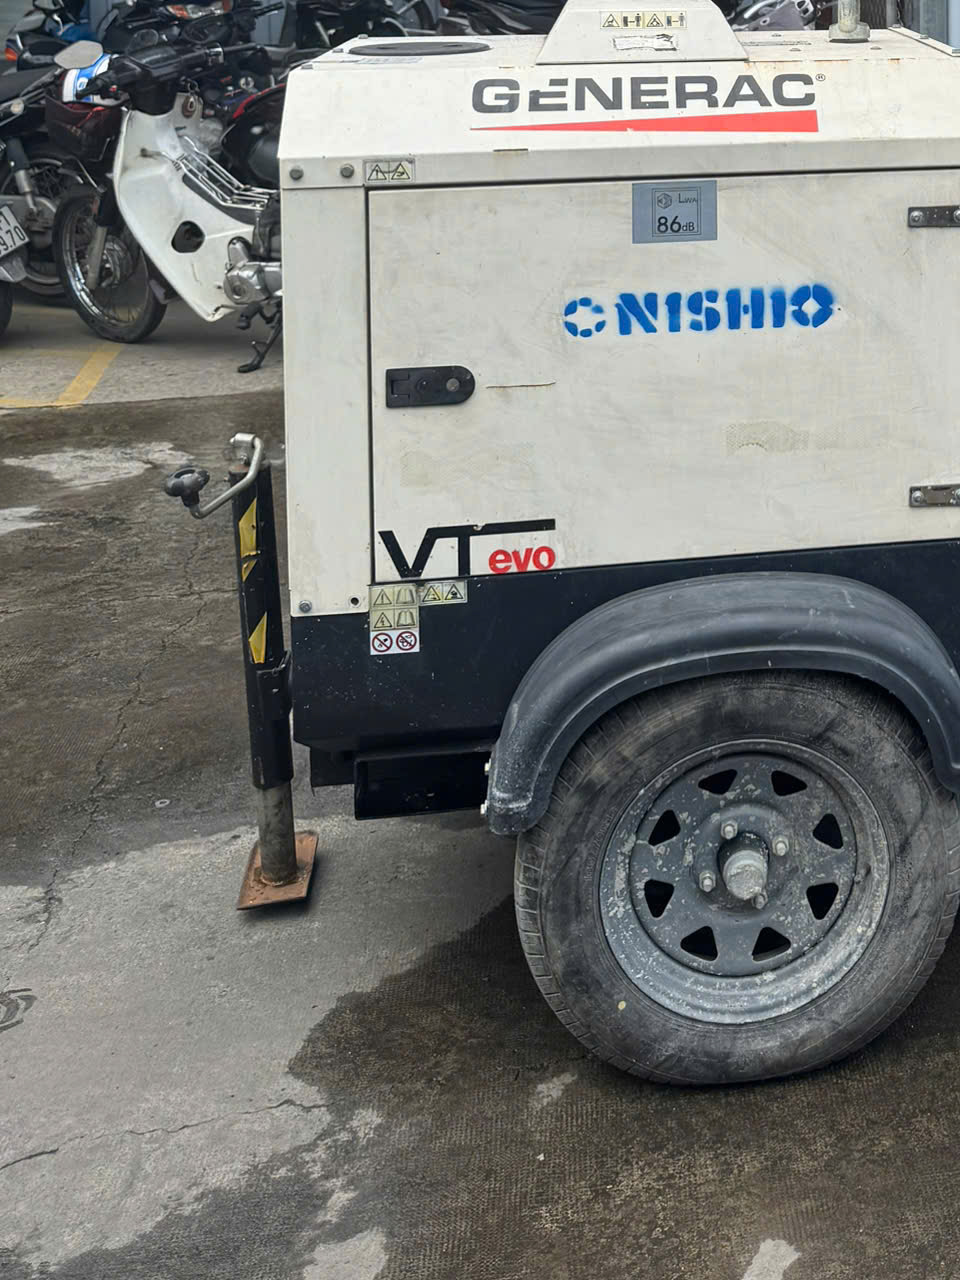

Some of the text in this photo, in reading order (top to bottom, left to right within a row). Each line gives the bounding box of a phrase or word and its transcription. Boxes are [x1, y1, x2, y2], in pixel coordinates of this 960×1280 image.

[471, 73, 817, 114] GENERAC
[0, 225, 26, 254] 9.70
[614, 283, 834, 336] NISHIO
[488, 545, 556, 574] evo
